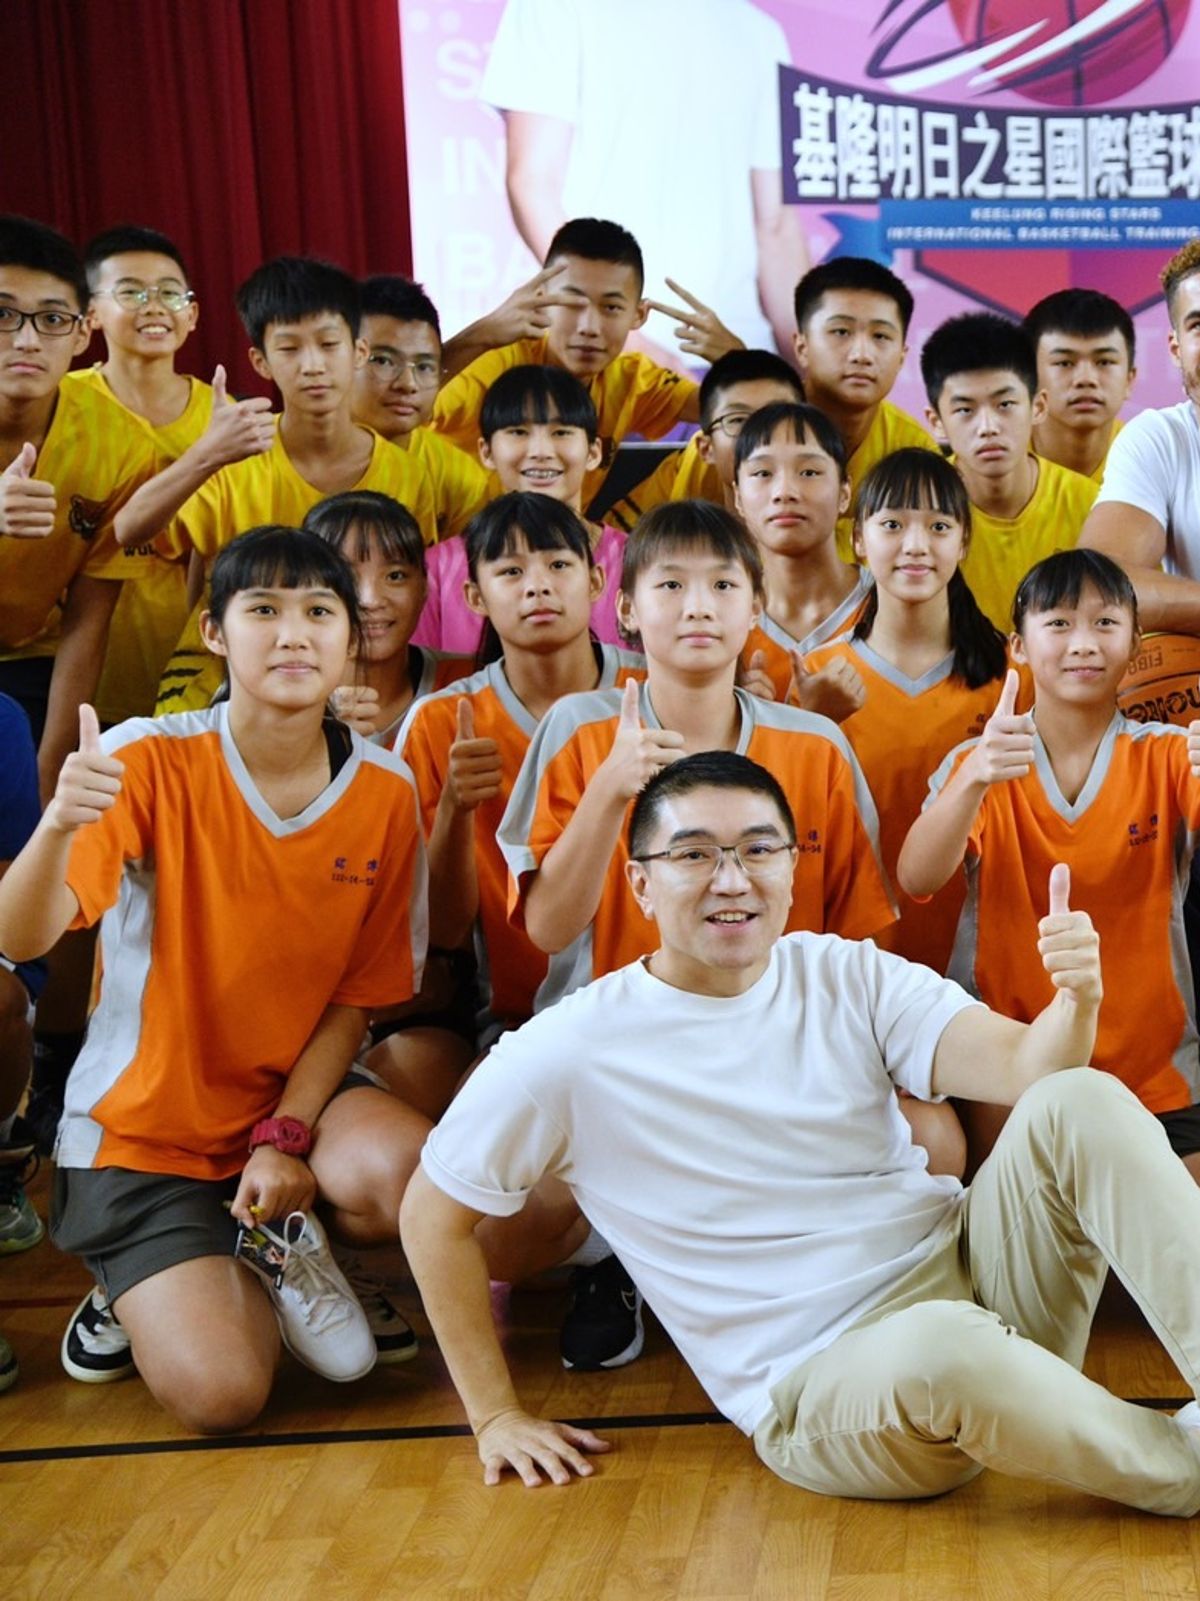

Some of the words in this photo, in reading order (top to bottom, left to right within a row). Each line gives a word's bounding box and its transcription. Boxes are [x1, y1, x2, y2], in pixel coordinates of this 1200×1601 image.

[970, 207, 1047, 221] KEELUNG
[1050, 207, 1105, 221] RISING
[1109, 207, 1162, 221] STARS
[886, 226, 1014, 241] INTERNATIONAL
[1017, 226, 1120, 241] BASKETBALL
[1125, 226, 1200, 241] TRAINING
